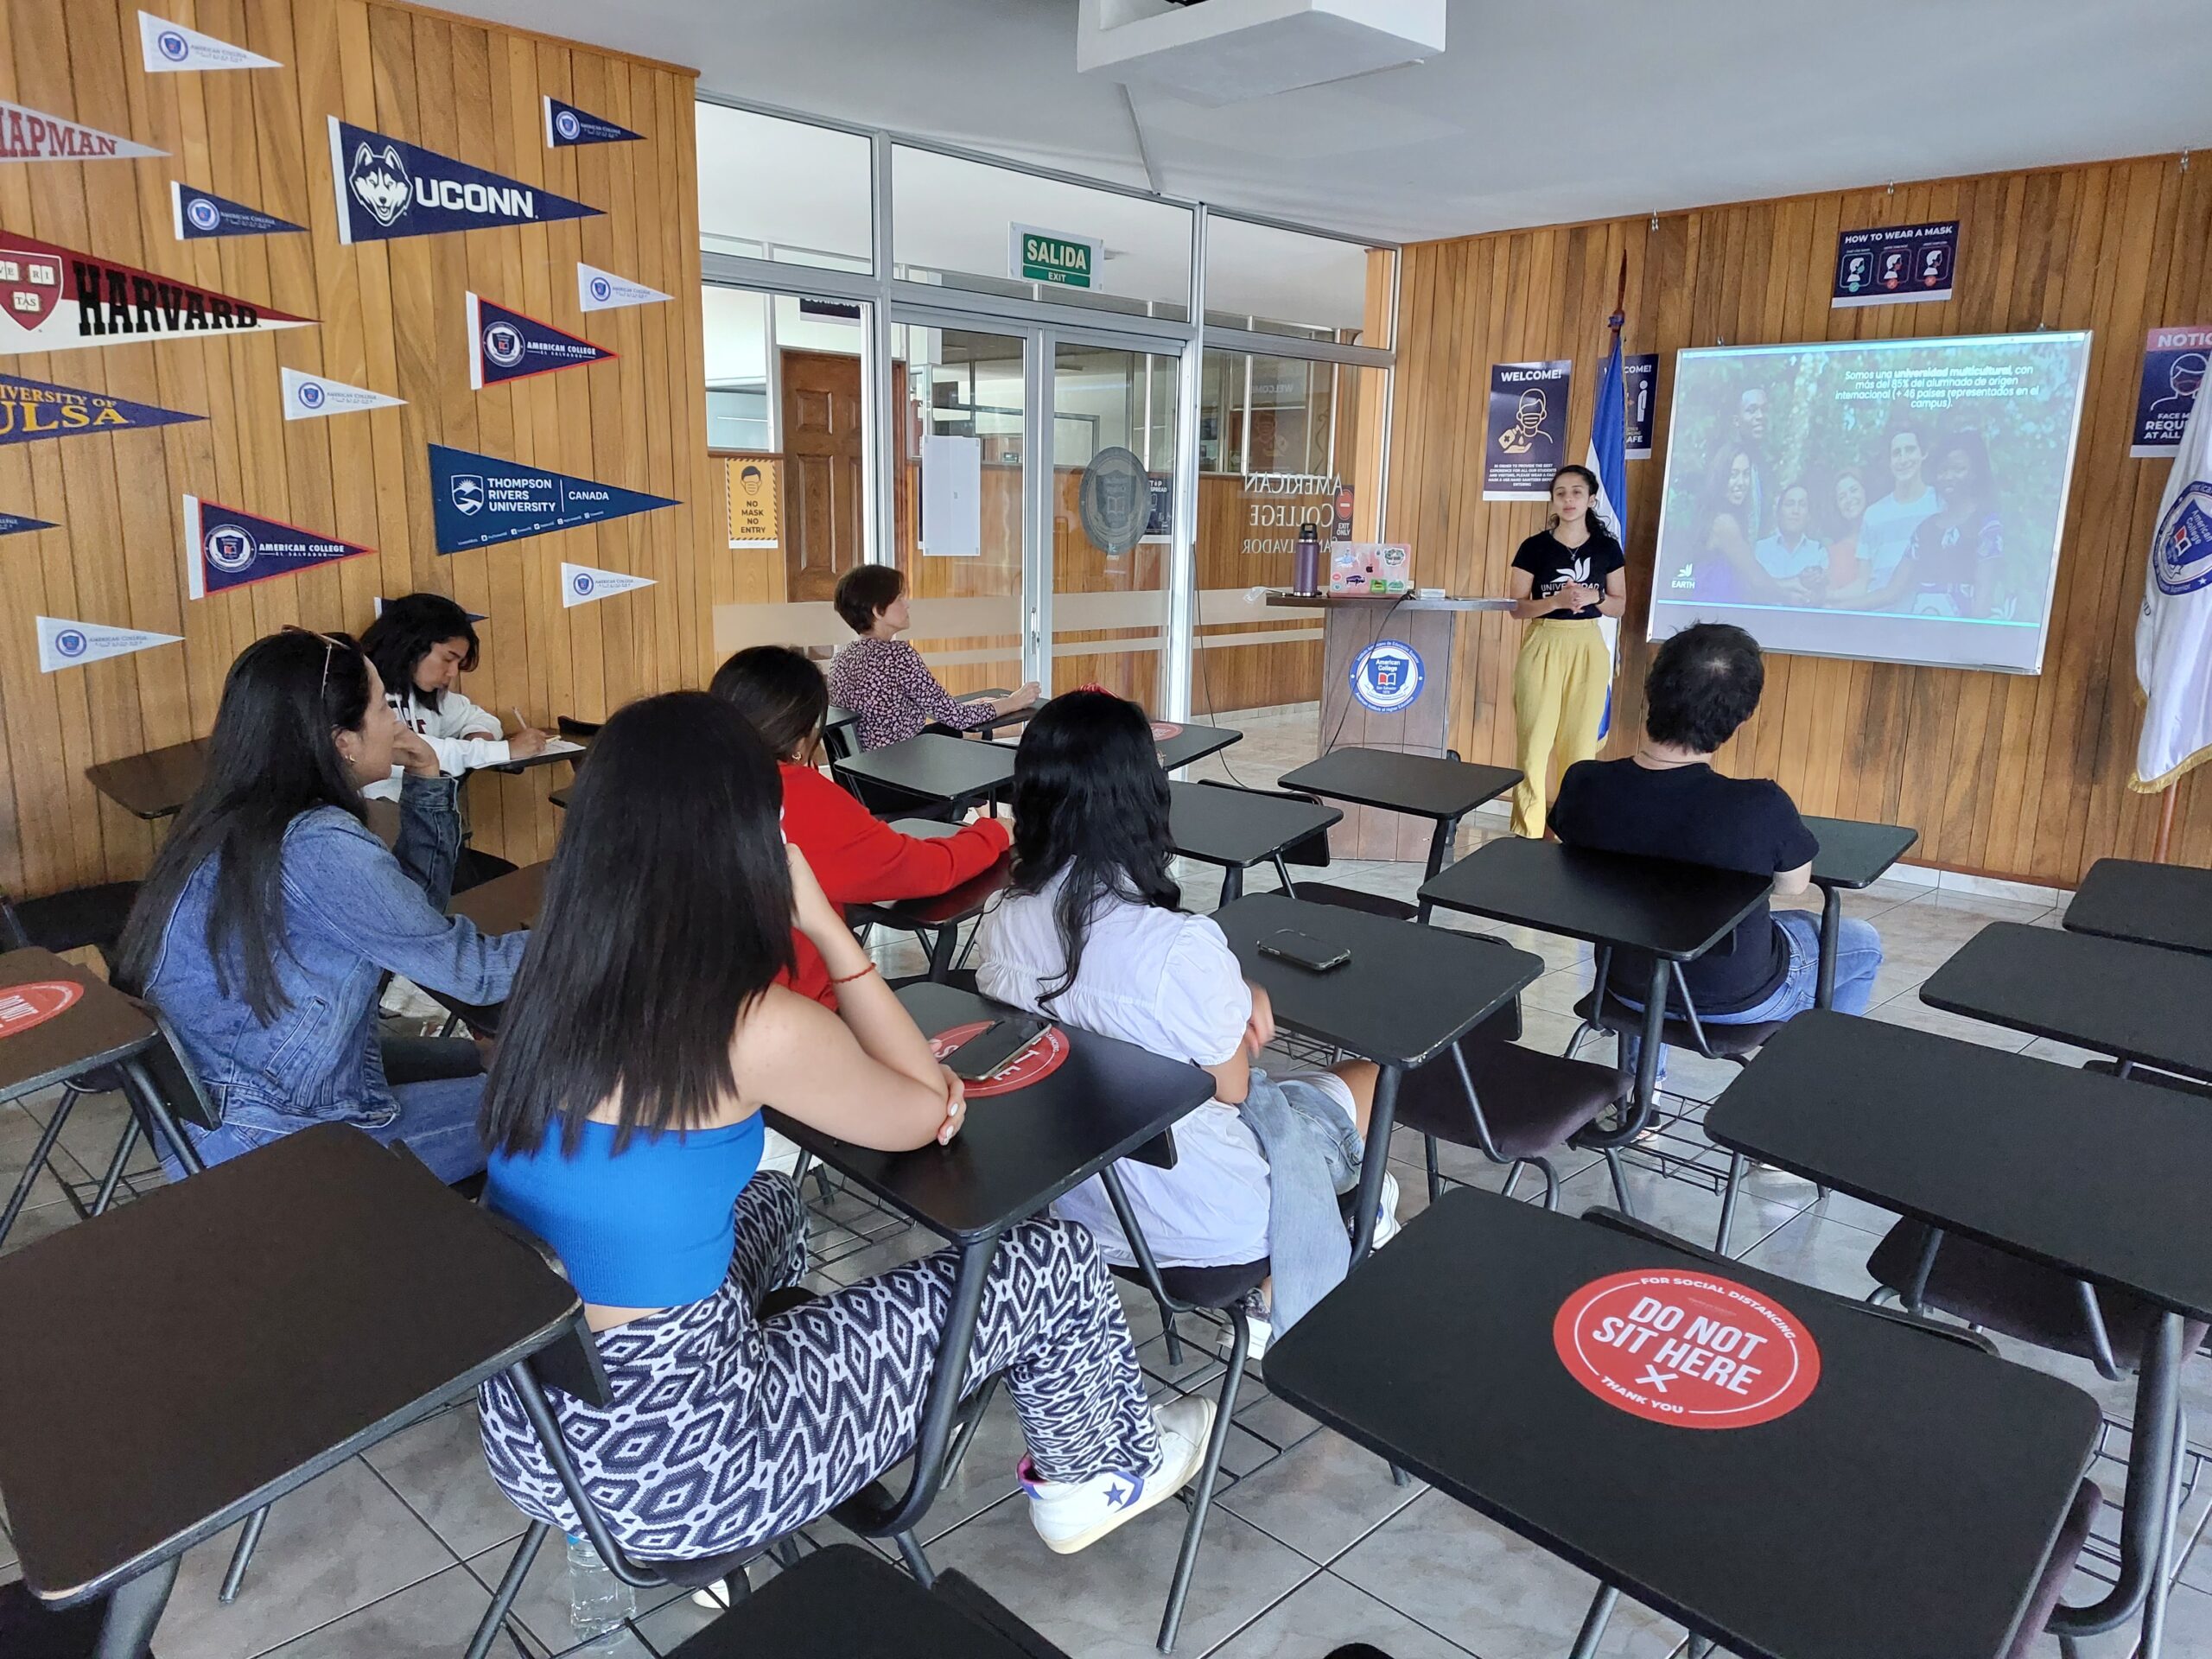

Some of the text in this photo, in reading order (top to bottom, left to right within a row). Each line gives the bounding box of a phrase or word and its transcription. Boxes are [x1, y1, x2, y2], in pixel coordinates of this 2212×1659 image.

[0, 106, 118, 157] APMAN
[414, 176, 534, 219] UCONN
[1845, 226, 1953, 244] HOW TO WEAR A MASK
[1027, 238, 1087, 270] SALIDA
[1048, 271, 1066, 283] EXIT
[72, 259, 258, 337] HARVARD
[526, 340, 596, 356] AMERICAN COLLEGE
[1500, 369, 1562, 382] WELCOME!
[1845, 370, 1874, 380] Somos
[1875, 370, 1892, 379] una
[1894, 366, 1948, 378] universidad
[2015, 365, 2034, 375] con
[1876, 379, 1890, 389] del
[1910, 378, 1925, 388] del
[1926, 377, 1973, 388] alumnado
[1974, 377, 1987, 386] de
[1834, 389, 1891, 400] internacional
[1904, 388, 1916, 398] 46
[1947, 385, 2014, 400] representados
[2016, 387, 2029, 396] en
[2030, 385, 2039, 396] el
[92, 397, 118, 408] OF
[2145, 420, 2187, 431] REQU
[1625, 435, 1643, 443] AFE
[2144, 431, 2158, 440] AT
[486, 477, 552, 490] THOMPSON
[488, 489, 610, 501] RIVERS CANADA
[488, 501, 556, 512] UNIVERSITY
[2186, 517, 2202, 545] College
[258, 543, 345, 553] AMERICAN COLLEGE
[1671, 580, 1695, 588] EARTH
[1641, 1276, 1671, 1285] FOR
[1673, 1277, 1726, 1295] SOCIAL
[1727, 1291, 1797, 1340] DISTANCING
[1628, 1296, 1685, 1332] DO
[1683, 1315, 1769, 1361] NOT
[1592, 1316, 1763, 1395] SIT HERE
[1600, 1375, 1684, 1414] THANK YOU
